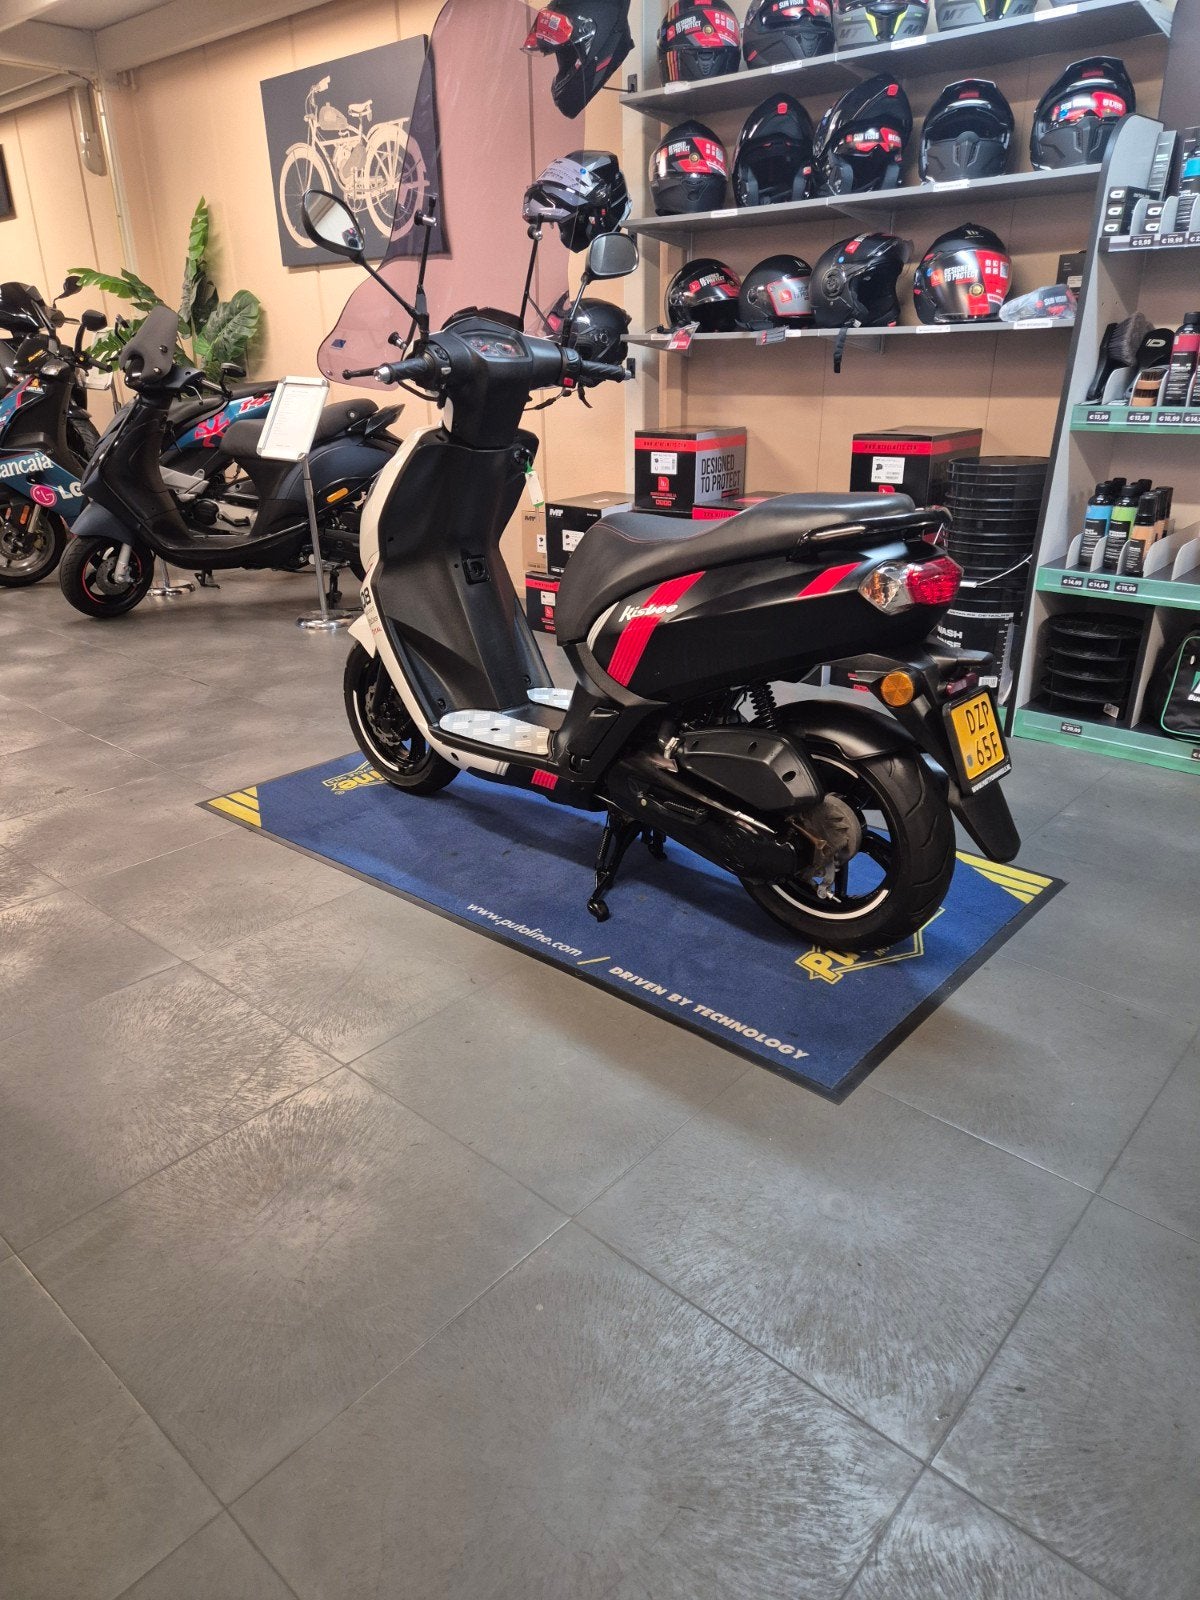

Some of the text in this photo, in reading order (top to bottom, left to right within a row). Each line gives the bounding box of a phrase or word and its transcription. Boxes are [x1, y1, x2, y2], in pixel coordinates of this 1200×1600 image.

[700, 470, 741, 493] TO PROTECT
[701, 454, 735, 475] DESIGNED
[618, 604, 678, 622] Kisbee
[965, 700, 989, 735] DZP
[976, 731, 998, 766] 65F
[466, 903, 583, 957] www.putoline.com
[608, 966, 810, 1060] DRIVEN BY TECHNOLOGY
